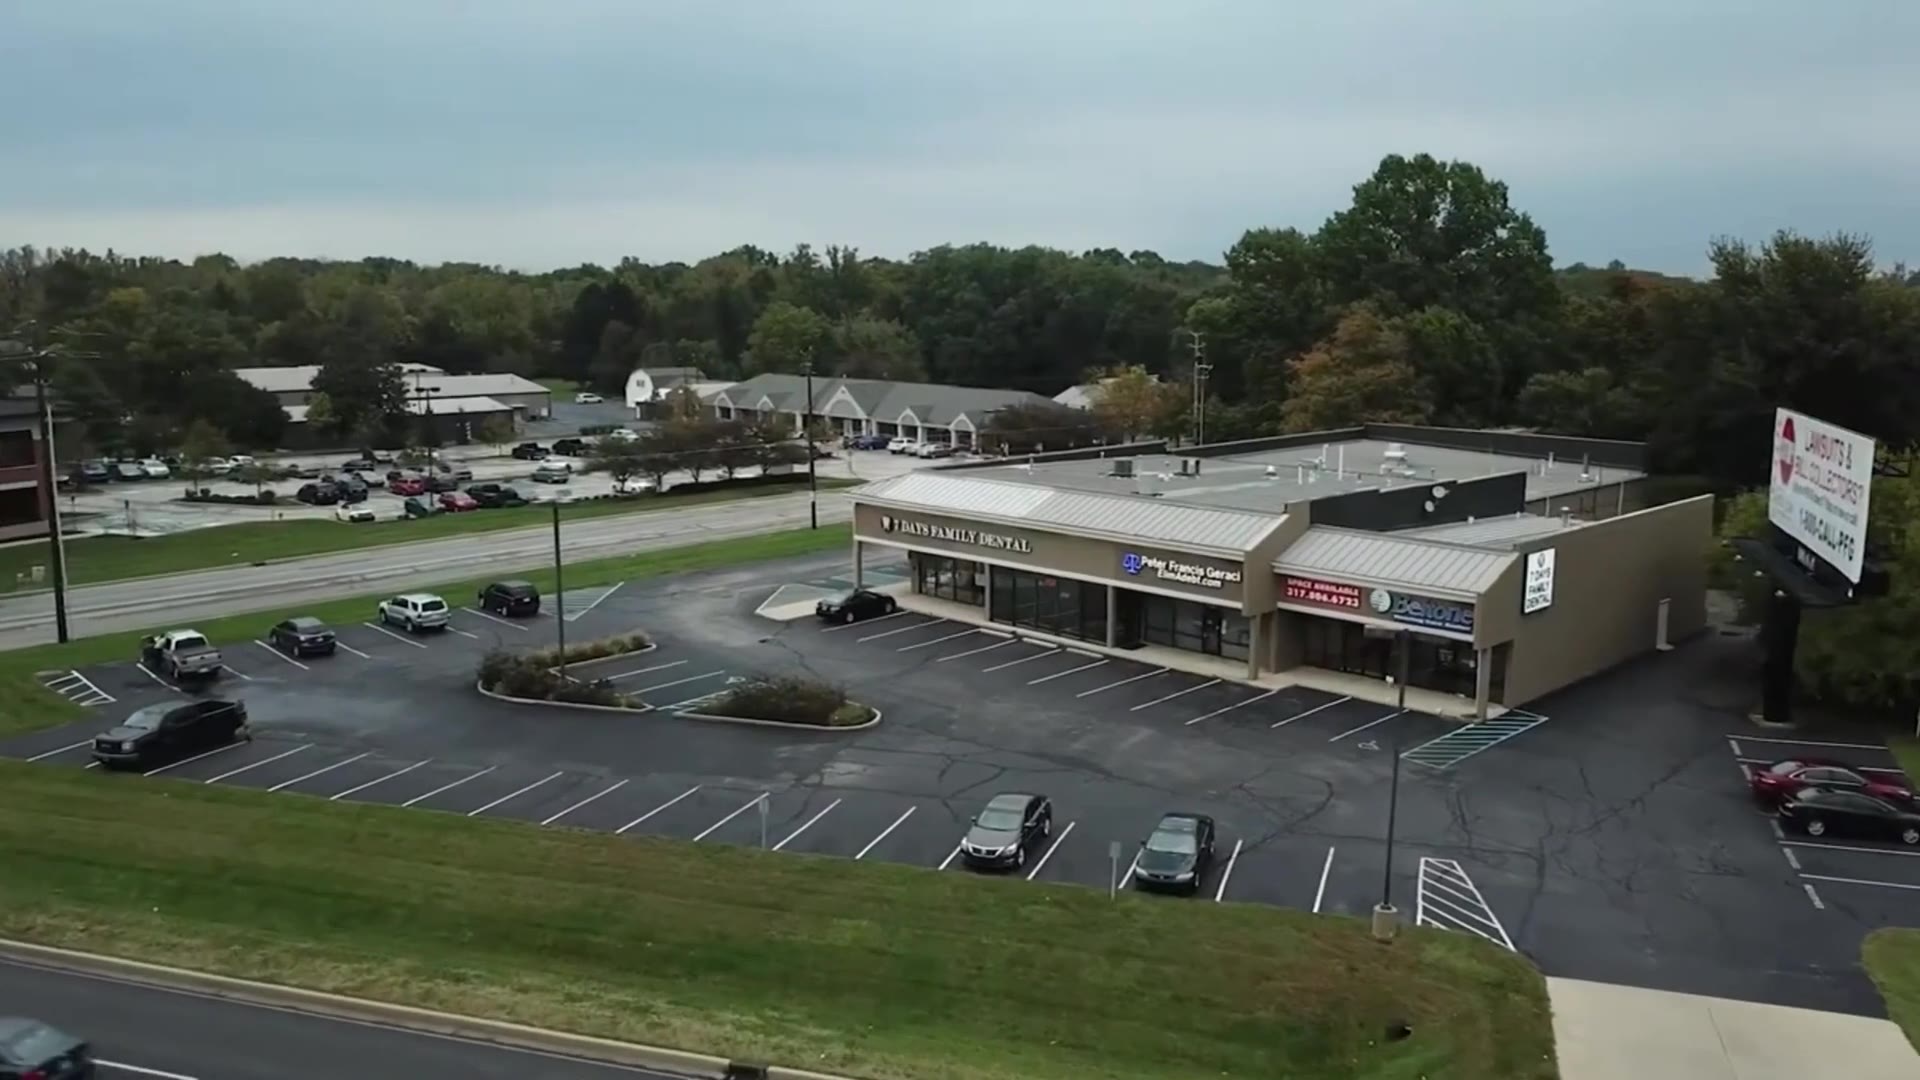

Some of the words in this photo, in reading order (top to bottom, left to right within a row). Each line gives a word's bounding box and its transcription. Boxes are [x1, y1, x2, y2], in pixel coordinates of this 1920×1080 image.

[1805, 431, 1844, 467] LAWSUITS
[893, 519, 900, 531] 7
[901, 520, 929, 536] DAYS
[930, 525, 977, 544] FAMILY
[978, 532, 1032, 553] DENTAL
[1141, 555, 1167, 569] Peter
[1168, 560, 1205, 577] Francis
[1206, 566, 1241, 582] Geraci
[1535, 567, 1551, 581] DAYS
[1529, 581, 1550, 597] FAMILY
[1527, 593, 1550, 609] DENTAL
